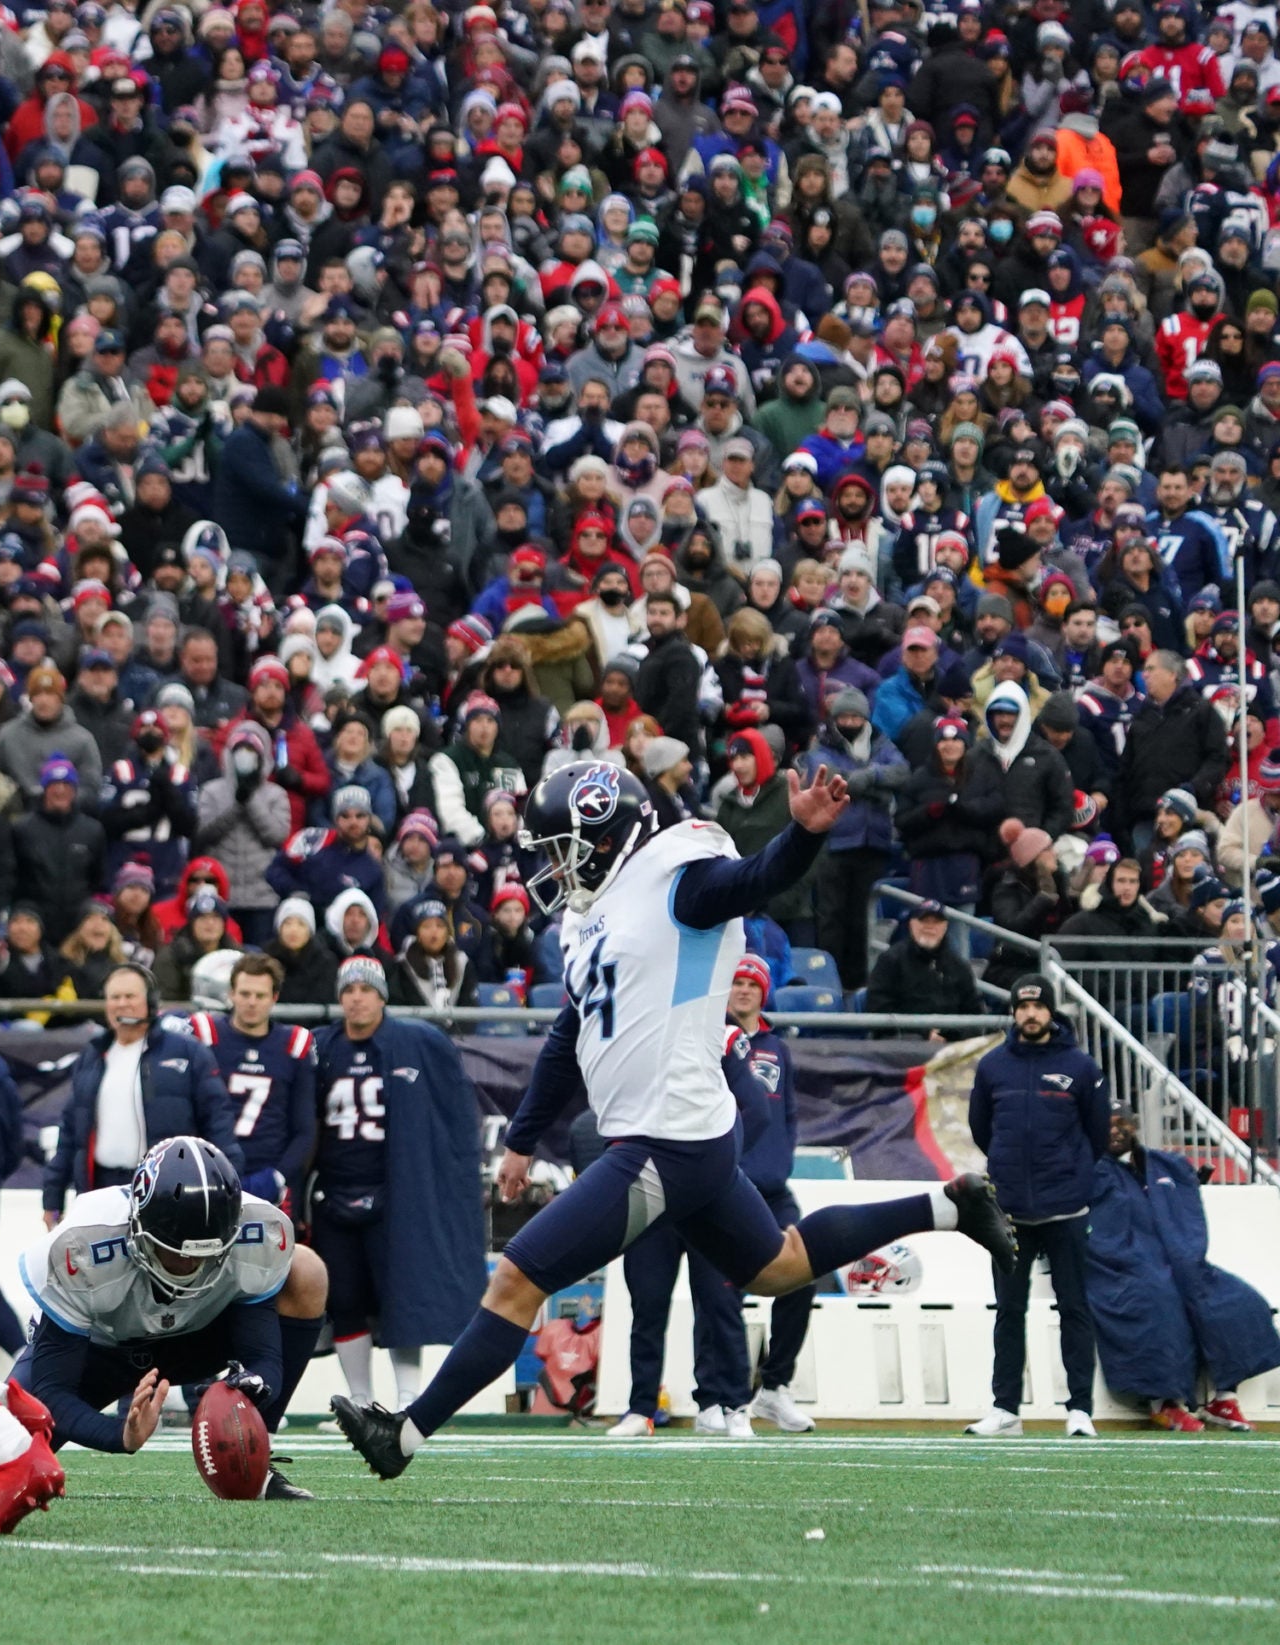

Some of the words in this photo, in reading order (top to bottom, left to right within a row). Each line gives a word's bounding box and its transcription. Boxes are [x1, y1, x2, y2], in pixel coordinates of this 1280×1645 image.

[578, 914, 606, 945] TITANS
[230, 1073, 273, 1137] 7
[326, 1076, 386, 1142] 49
[89, 1236, 130, 1265] 6
